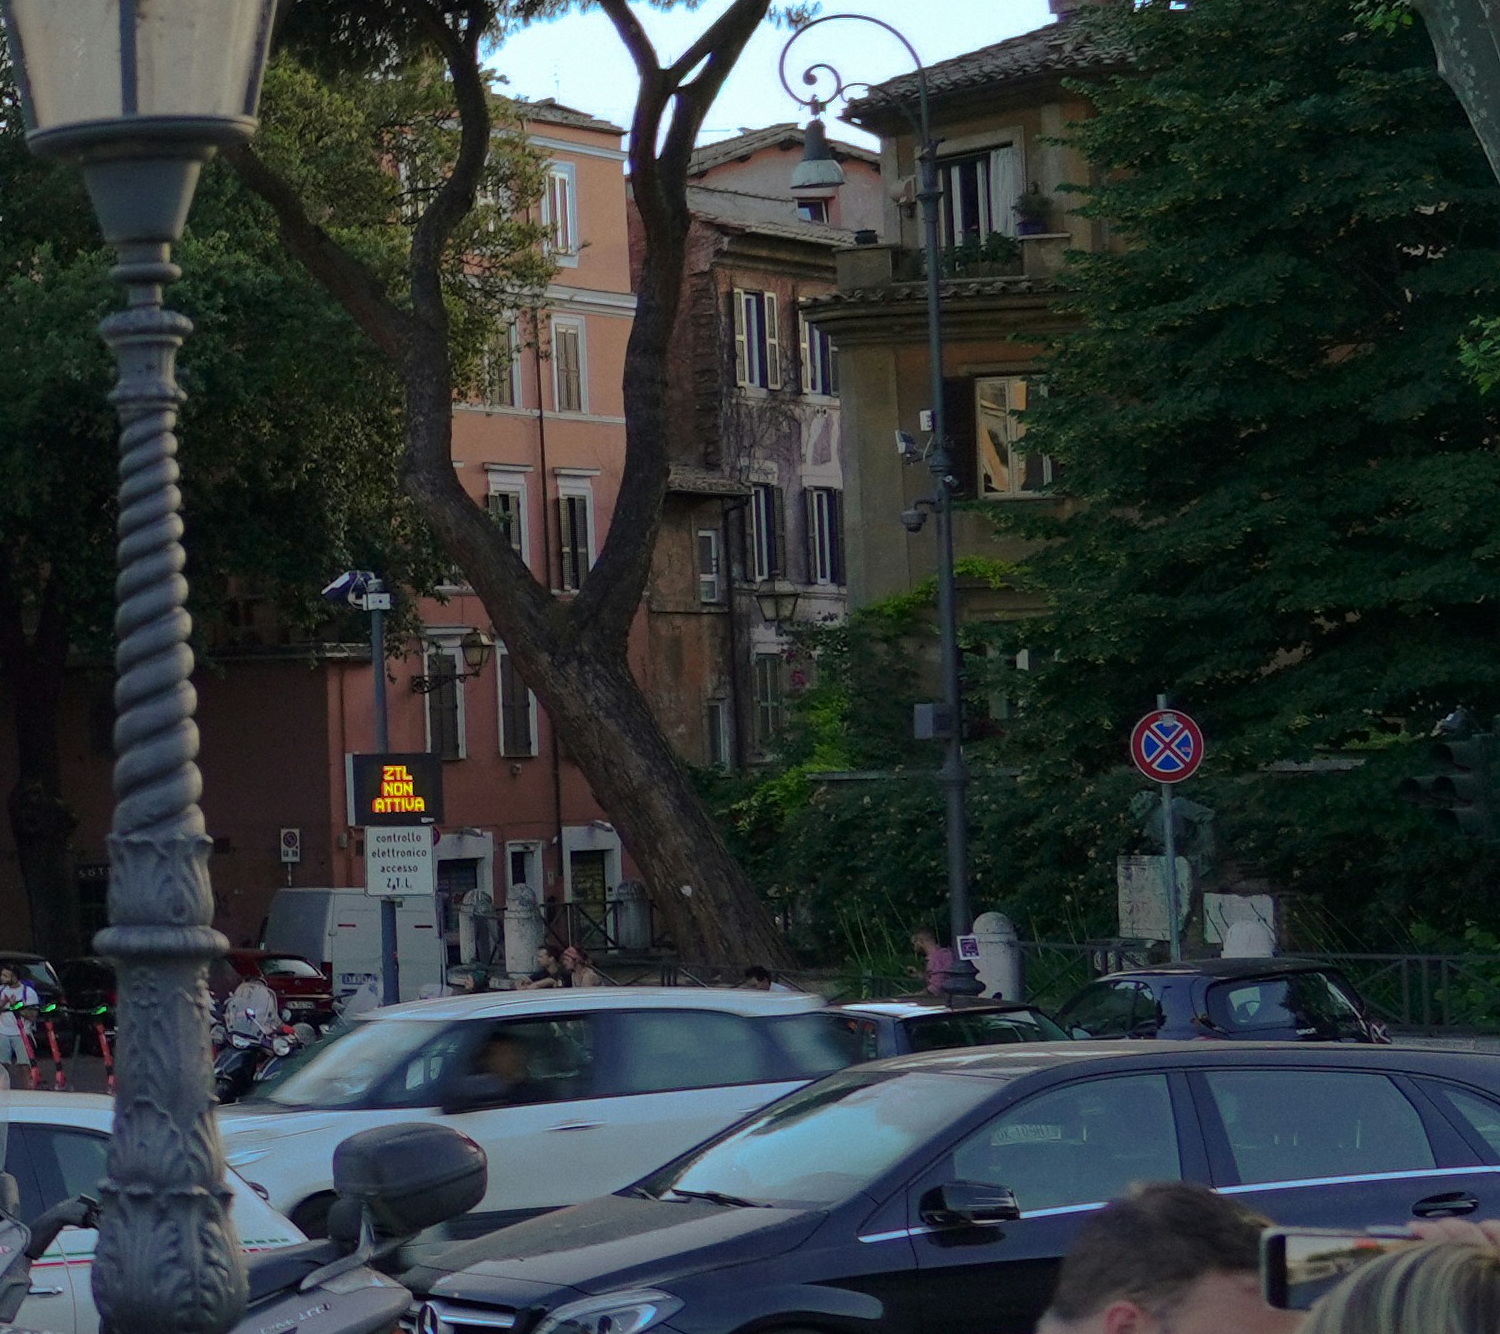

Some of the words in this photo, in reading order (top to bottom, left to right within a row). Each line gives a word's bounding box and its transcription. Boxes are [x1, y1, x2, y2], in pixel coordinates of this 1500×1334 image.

[382, 765, 414, 781] ZTL
[381, 781, 414, 797] NON
[372, 797, 425, 813] ATTIVA
[376, 832, 422, 843] controllo
[371, 847, 427, 859] elettronico
[380, 864, 419, 873] accesso
